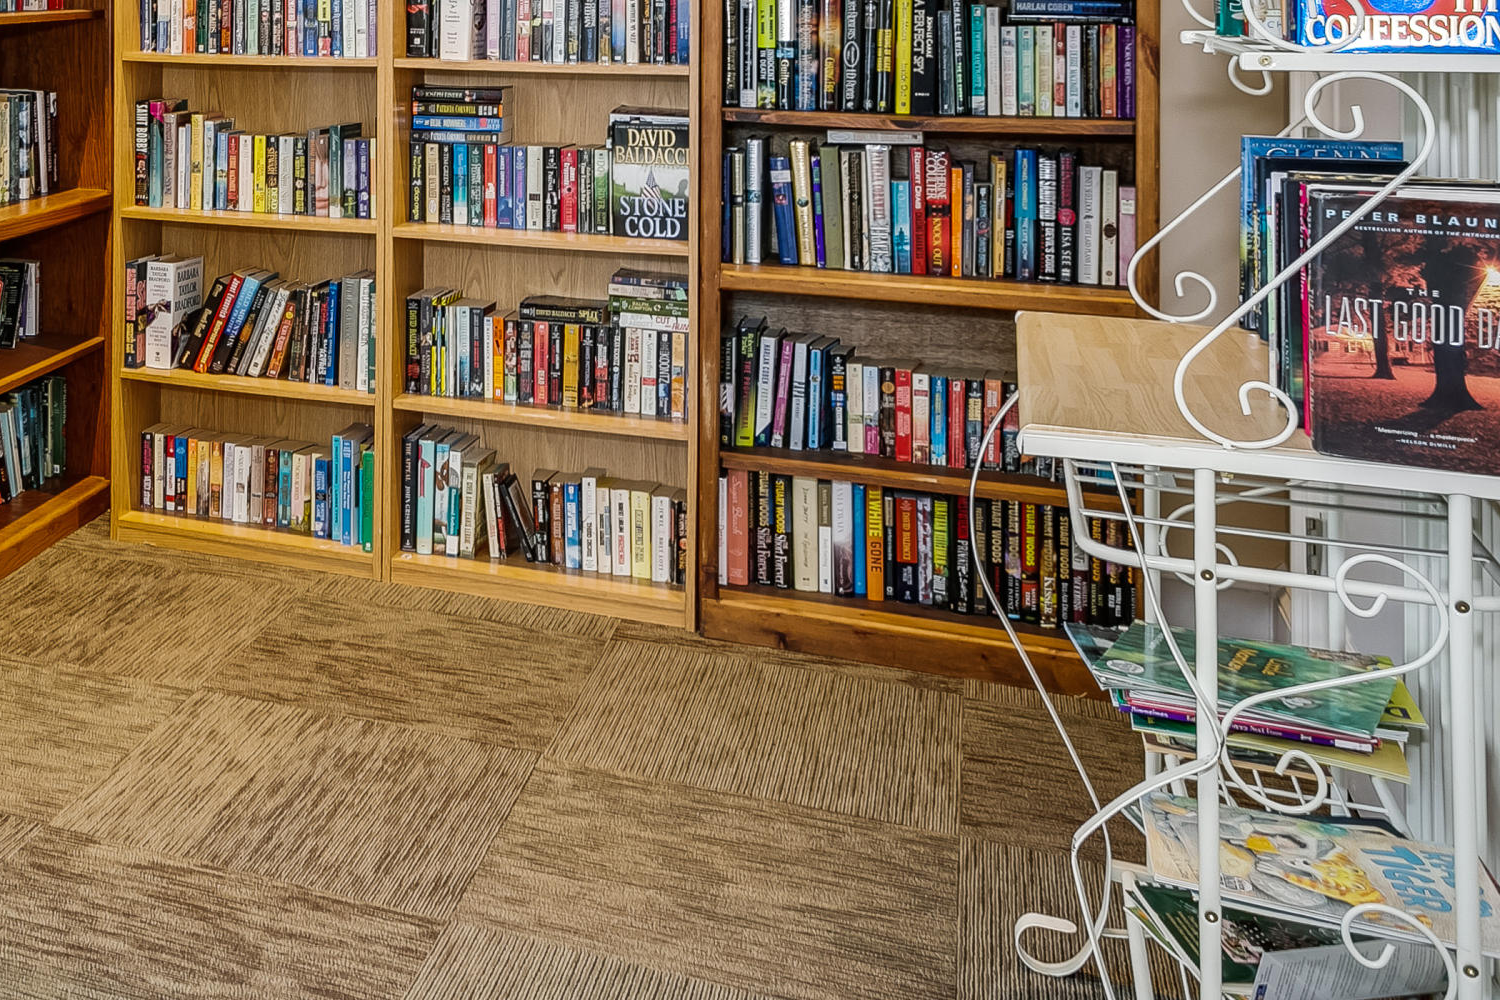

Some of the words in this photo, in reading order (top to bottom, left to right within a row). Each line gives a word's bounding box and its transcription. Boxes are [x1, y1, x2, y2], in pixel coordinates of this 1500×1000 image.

[1016, 1, 1046, 11] HARLAN
[1047, 2, 1074, 12] COBEN
[846, 11, 858, 39] ROBERTS
[913, 9, 926, 54] PERFECT
[926, 15, 934, 31] JOHN
[1305, 13, 1500, 47] CONFESSION
[760, 49, 768, 57] IN
[954, 31, 963, 57] LEWIS
[760, 58, 768, 80] DEATH
[767, 48, 775, 81] INNOCENT
[779, 59, 790, 86] Guilty
[913, 54, 926, 74] SPY
[1124, 55, 1132, 79] ROBERTS
[846, 80, 858, 99] ROBB
[136, 104, 148, 126] SAINT
[136, 127, 148, 153] BOBBY
[628, 128, 676, 147] DAVID
[616, 146, 689, 165] BALDACCI
[915, 151, 923, 184] ROBERT
[442, 164, 450, 186] GREEN
[927, 156, 938, 200] COULTER
[938, 157, 948, 200] CATHERINE
[1021, 158, 1029, 187] MICHAEL
[1040, 158, 1057, 181] JOHN
[1084, 168, 1094, 188] SIDNEY
[270, 186, 278, 209] DEAD
[620, 197, 687, 218] STONE
[915, 185, 923, 209] CRAIS
[1021, 187, 1029, 211] CONNELLY
[1040, 181, 1057, 221] SANDFORD
[1084, 189, 1094, 214] SHELDON
[625, 216, 681, 238] COLD
[1021, 217, 1029, 226] THE
[1325, 208, 1399, 223] PEER
[931, 217, 943, 247] KNOCK
[1021, 227, 1029, 243] LATE
[1045, 227, 1055, 250] DEVIL'S
[1061, 226, 1072, 243] LISA
[931, 251, 943, 268] OUT
[1021, 244, 1029, 261] SHOW
[1045, 251, 1055, 274] CODE
[1061, 246, 1072, 266] SEE
[150, 265, 169, 273] BARBARA
[177, 268, 199, 283] BARBARA
[178, 281, 197, 296] TAYLOR
[242, 285, 256, 306] COLD
[1405, 288, 1440, 298] THE
[174, 294, 201, 313] BRADFORD
[226, 306, 248, 347] MOUNTAIN
[409, 309, 417, 327] DAVID
[655, 316, 670, 324] CUT
[1325, 294, 1383, 340] LAST
[1393, 301, 1464, 347] GOOD
[409, 327, 417, 356] BALDACCI
[763, 343, 772, 367] HARLAN
[658, 353, 670, 383] KOONTZ
[742, 360, 753, 375] THE
[763, 367, 772, 385] COBEN
[742, 376, 753, 429] PROFESSIONAL
[404, 442, 412, 456] THE
[404, 457, 412, 482] APPEAL
[404, 485, 412, 504] JOHN
[729, 476, 743, 504] Sugar
[759, 471, 769, 498] STUART
[775, 482, 786, 506] STUART
[404, 504, 412, 534] GRISHAM
[729, 506, 743, 536] Beach
[759, 498, 769, 527] WOODS
[775, 507, 786, 534] WOODS
[869, 500, 882, 537] WHITE
[902, 511, 911, 531] DAVID
[1008, 500, 1019, 533] STUART
[1025, 504, 1036, 534] STUART
[1044, 505, 1055, 537] STUART
[756, 527, 768, 549] Short
[1059, 516, 1070, 547] STUART
[774, 534, 786, 554] Short
[902, 531, 911, 560] BALDACCI
[958, 539, 969, 571] PRIVATE
[975, 531, 985, 561] ABANDON
[991, 529, 1002, 564] WOODS
[1025, 535, 1036, 566] WOODS
[1044, 539, 1055, 573] WOODS
[869, 541, 882, 572] GONE
[1059, 547, 1070, 579] WOODS
[934, 574, 947, 595] GUILT
[1044, 575, 1055, 614] KISSER
[1091, 583, 1099, 616] MAHOGANY
[1114, 604, 1122, 617] HILLS
[1360, 845, 1452, 913] TIGER
